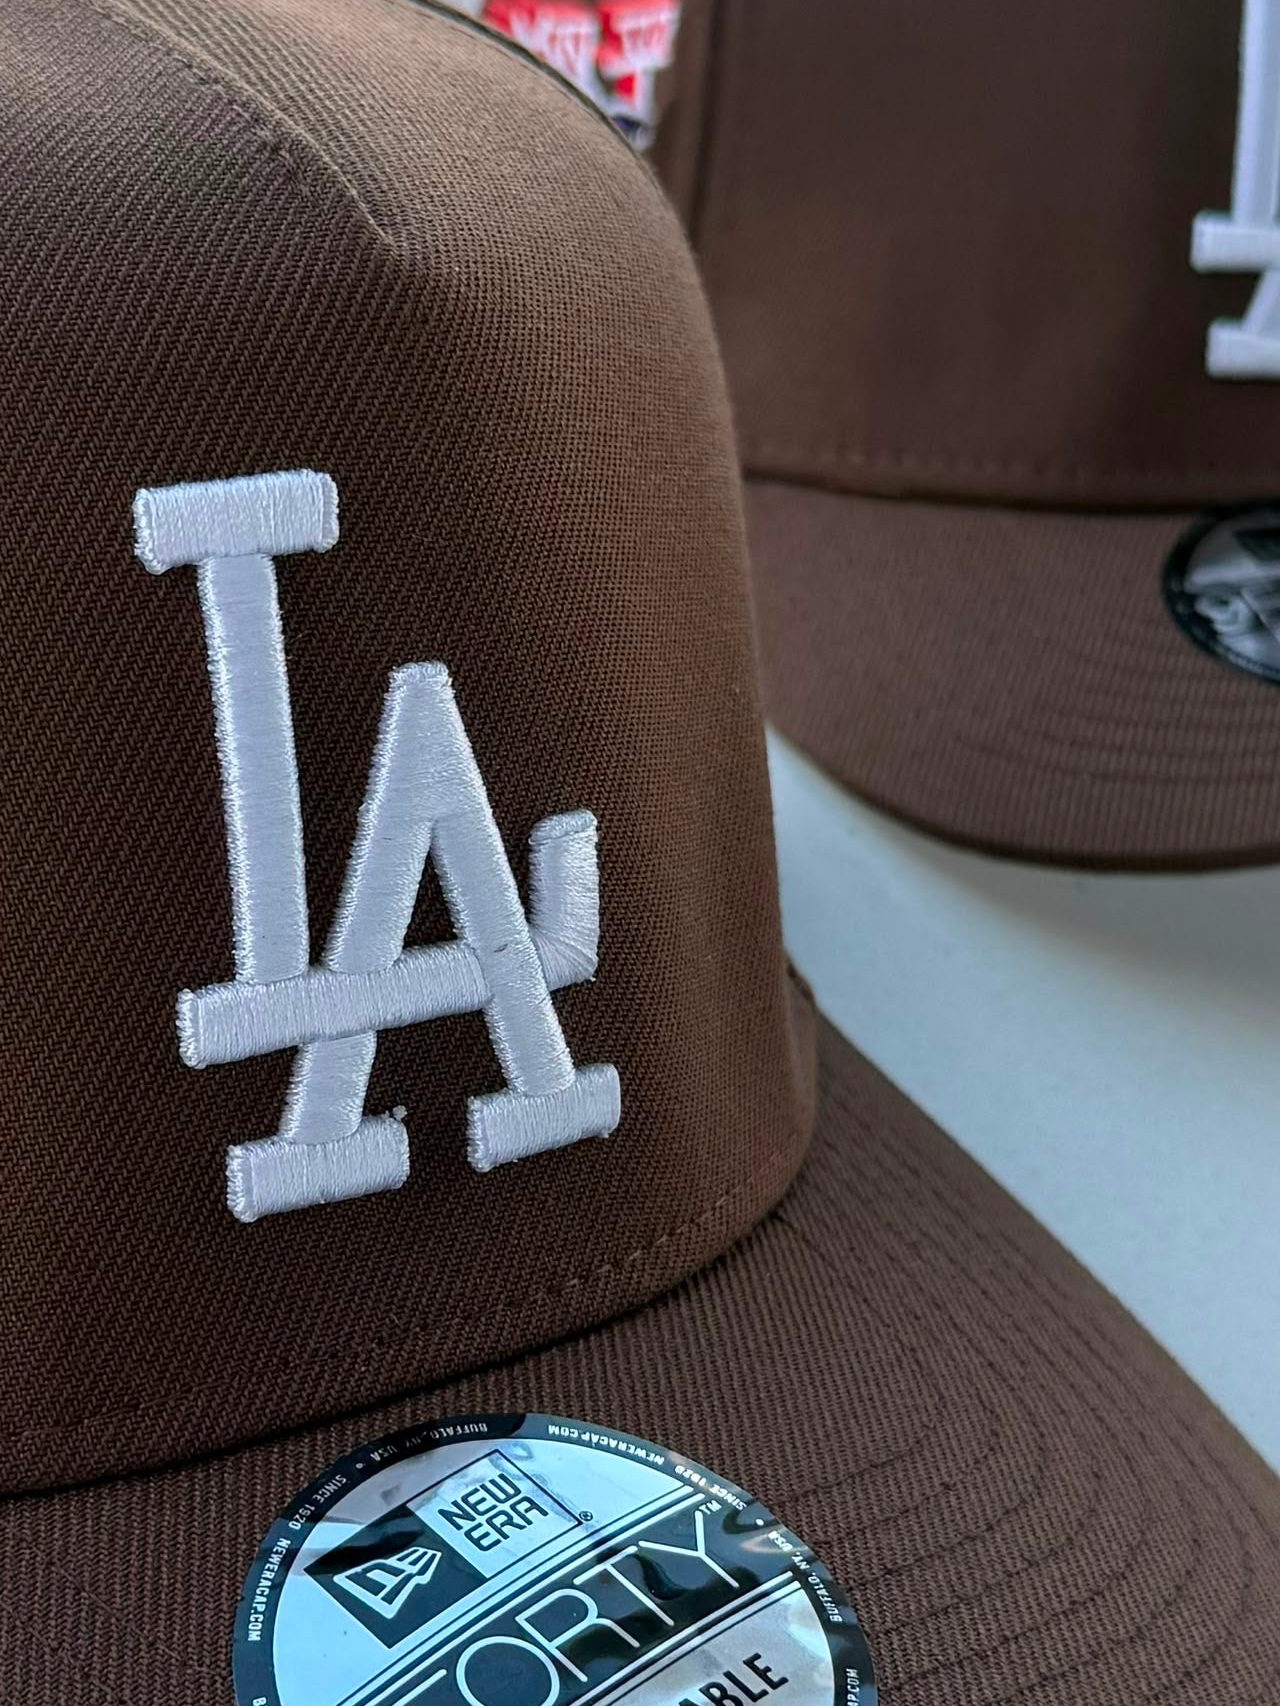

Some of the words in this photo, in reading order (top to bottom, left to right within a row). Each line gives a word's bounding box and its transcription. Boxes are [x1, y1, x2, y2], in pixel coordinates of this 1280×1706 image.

[132, 468, 622, 1223] LA
[291, 1504, 316, 1531] 1920
[437, 1473, 522, 1531] NEW
[463, 1496, 549, 1552] ERA
[247, 1538, 291, 1641] NEWERACAP.COM
